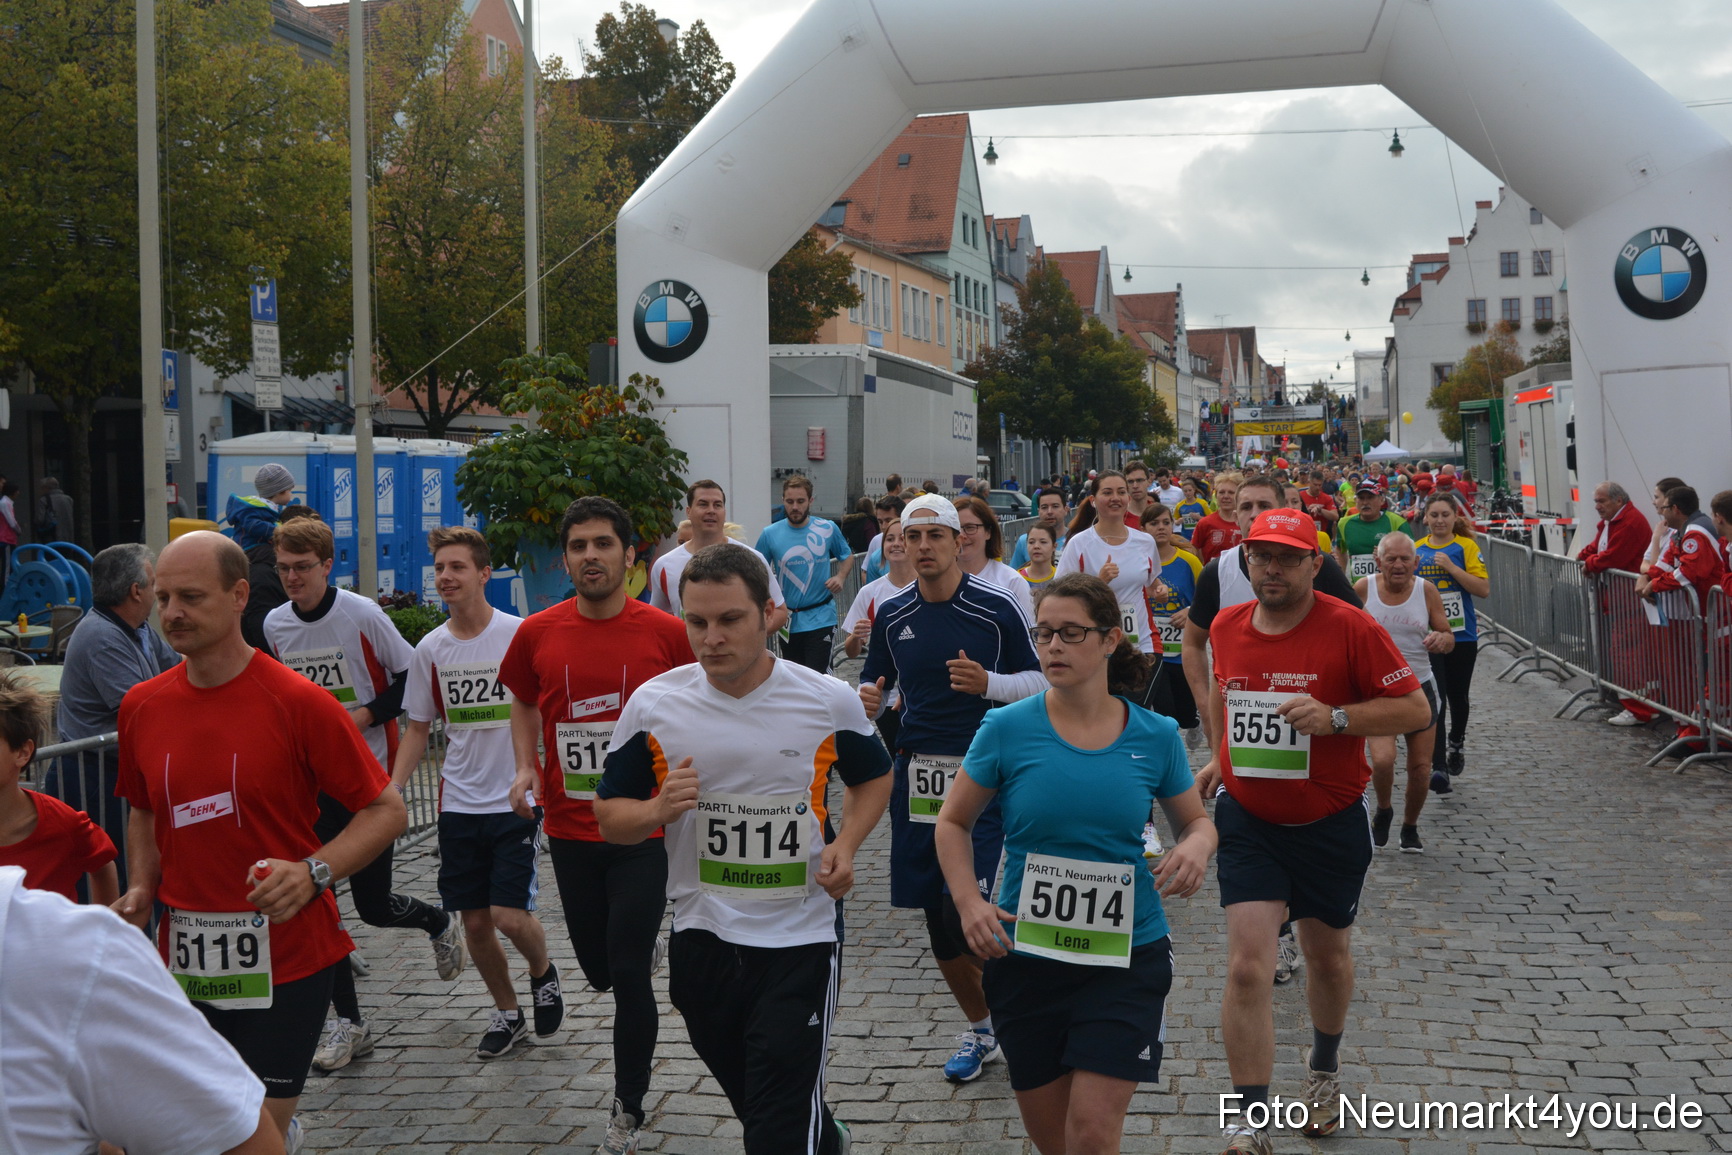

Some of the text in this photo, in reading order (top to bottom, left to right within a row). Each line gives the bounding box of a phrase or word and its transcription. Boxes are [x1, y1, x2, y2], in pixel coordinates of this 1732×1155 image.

[1621, 228, 1699, 262] BMW
[638, 281, 702, 309] BMW
[1263, 423, 1295, 433] START
[200, 433, 207, 451] 3
[284, 654, 334, 665] PARTL Neumarkt
[293, 662, 344, 687] 221
[440, 668, 497, 678] PARTL Neumarkt
[1272, 672, 1318, 680] NEUMARKTER
[447, 678, 506, 705] 5224
[585, 700, 607, 711] DEHN
[1228, 699, 1253, 708] PARTL
[459, 709, 495, 721] Michael
[558, 730, 585, 738] PARTL
[911, 758, 935, 767] PARTL
[190, 802, 217, 817] DEHN
[697, 801, 791, 816] PARTL Neumarkt
[707, 818, 800, 859] 5114
[721, 867, 782, 885] Andreas
[1026, 863, 1117, 883] PARTL Neumarkt
[1030, 880, 1124, 927] 5014
[170, 914, 247, 928] PARTL Neumarkt
[1054, 931, 1090, 950] Lena
[176, 931, 259, 971] 5119
[185, 980, 242, 996] Michael
